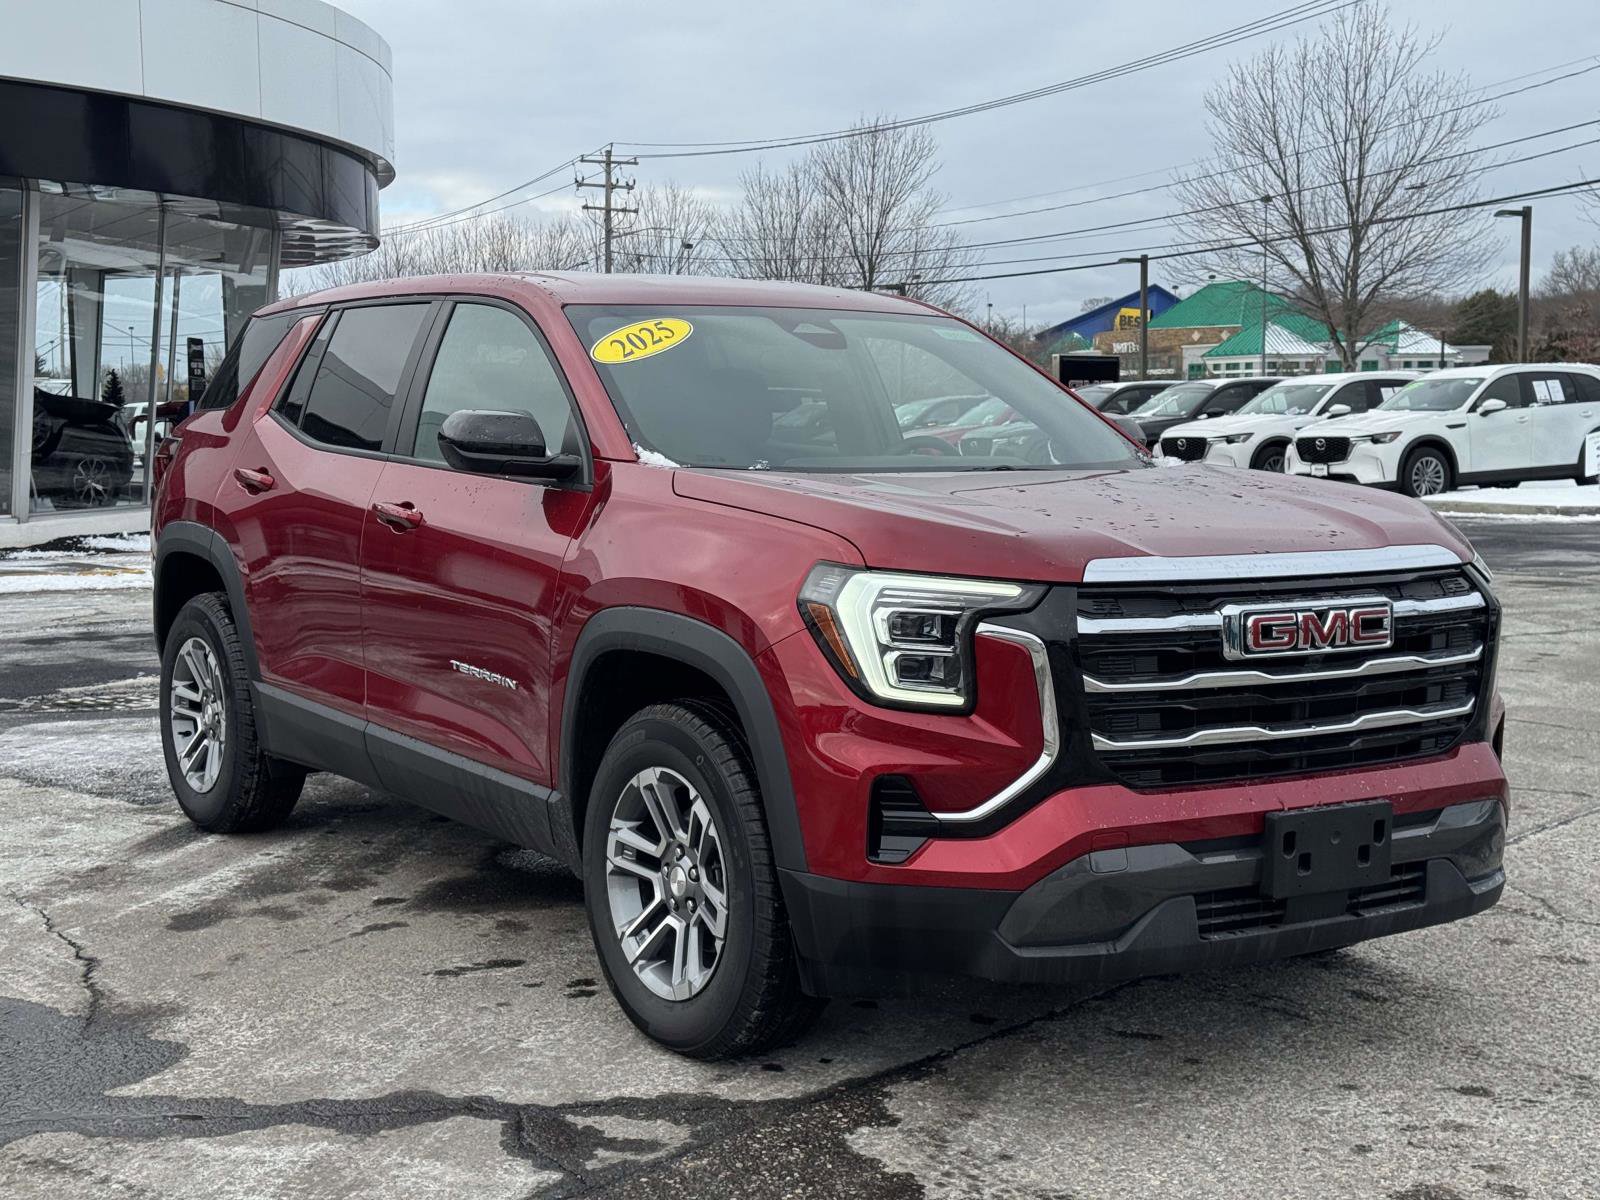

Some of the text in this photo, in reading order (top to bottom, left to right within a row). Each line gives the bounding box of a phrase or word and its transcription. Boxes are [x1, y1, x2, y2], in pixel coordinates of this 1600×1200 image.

[1119, 315, 1142, 327] BES
[610, 321, 675, 358] 2025
[1247, 606, 1390, 650] GMC
[449, 659, 518, 690] TERRAIN
